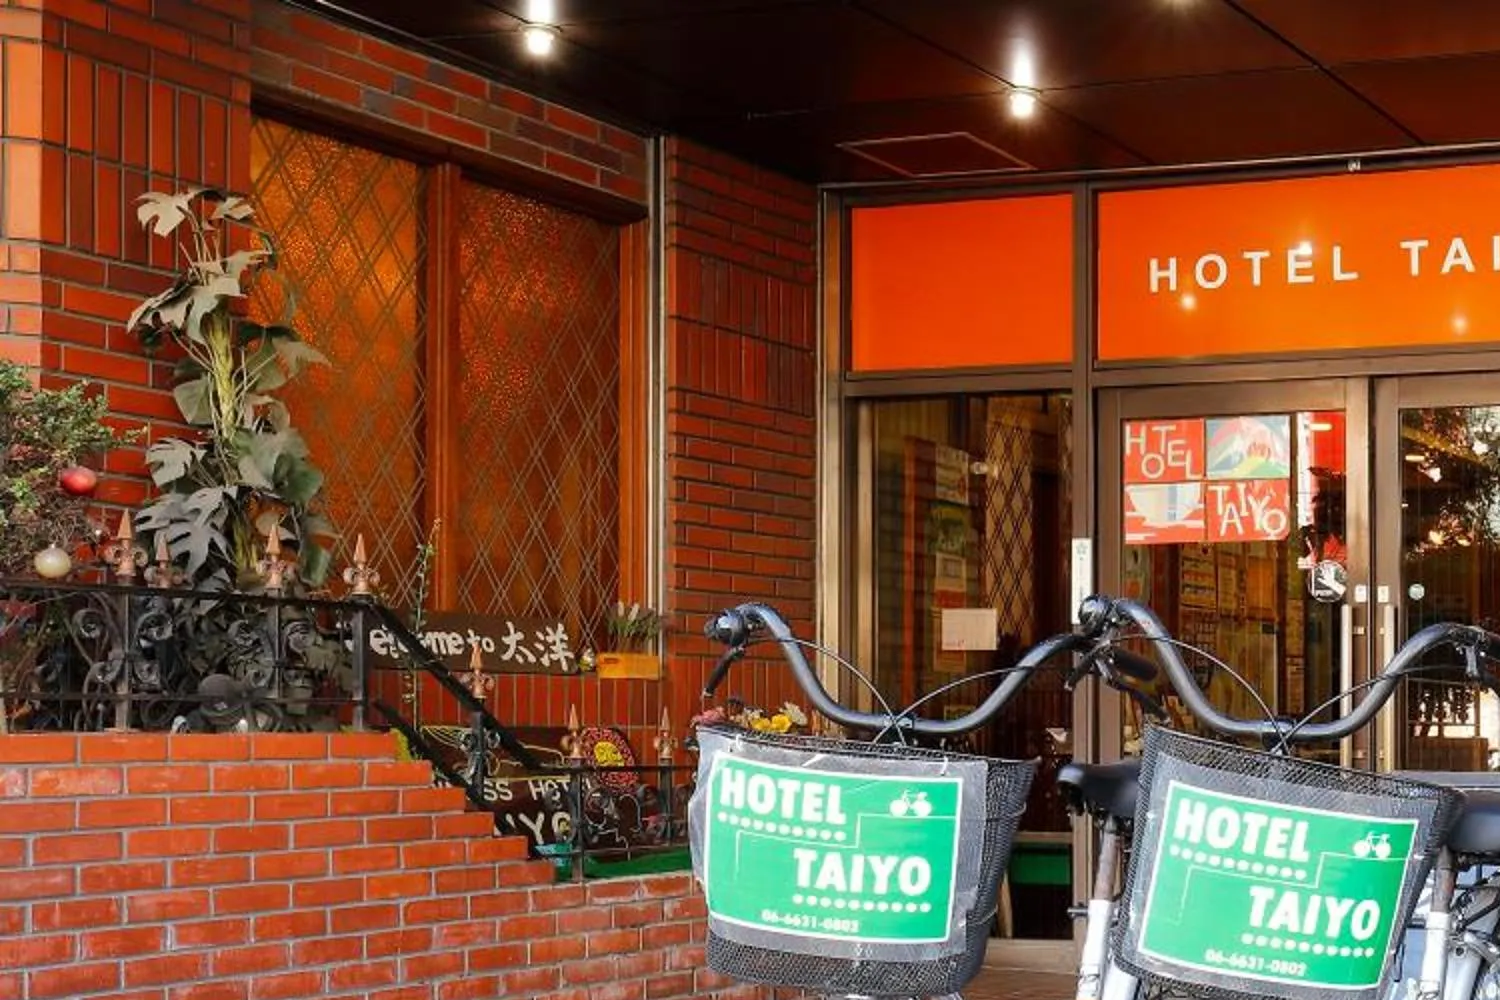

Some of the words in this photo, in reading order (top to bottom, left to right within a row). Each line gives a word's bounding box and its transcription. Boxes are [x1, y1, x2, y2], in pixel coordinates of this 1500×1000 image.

[1148, 244, 1358, 293] HOTEL
[1125, 424, 1201, 479] HOTEL
[1208, 482, 1287, 536] TAIYO
[467, 628, 495, 653] to
[501, 621, 574, 672] 太洋
[719, 767, 846, 825] HOTEL
[1173, 798, 1309, 862] HOTEL
[794, 848, 931, 896] TAIYO
[1249, 886, 1381, 941] TAIYO
